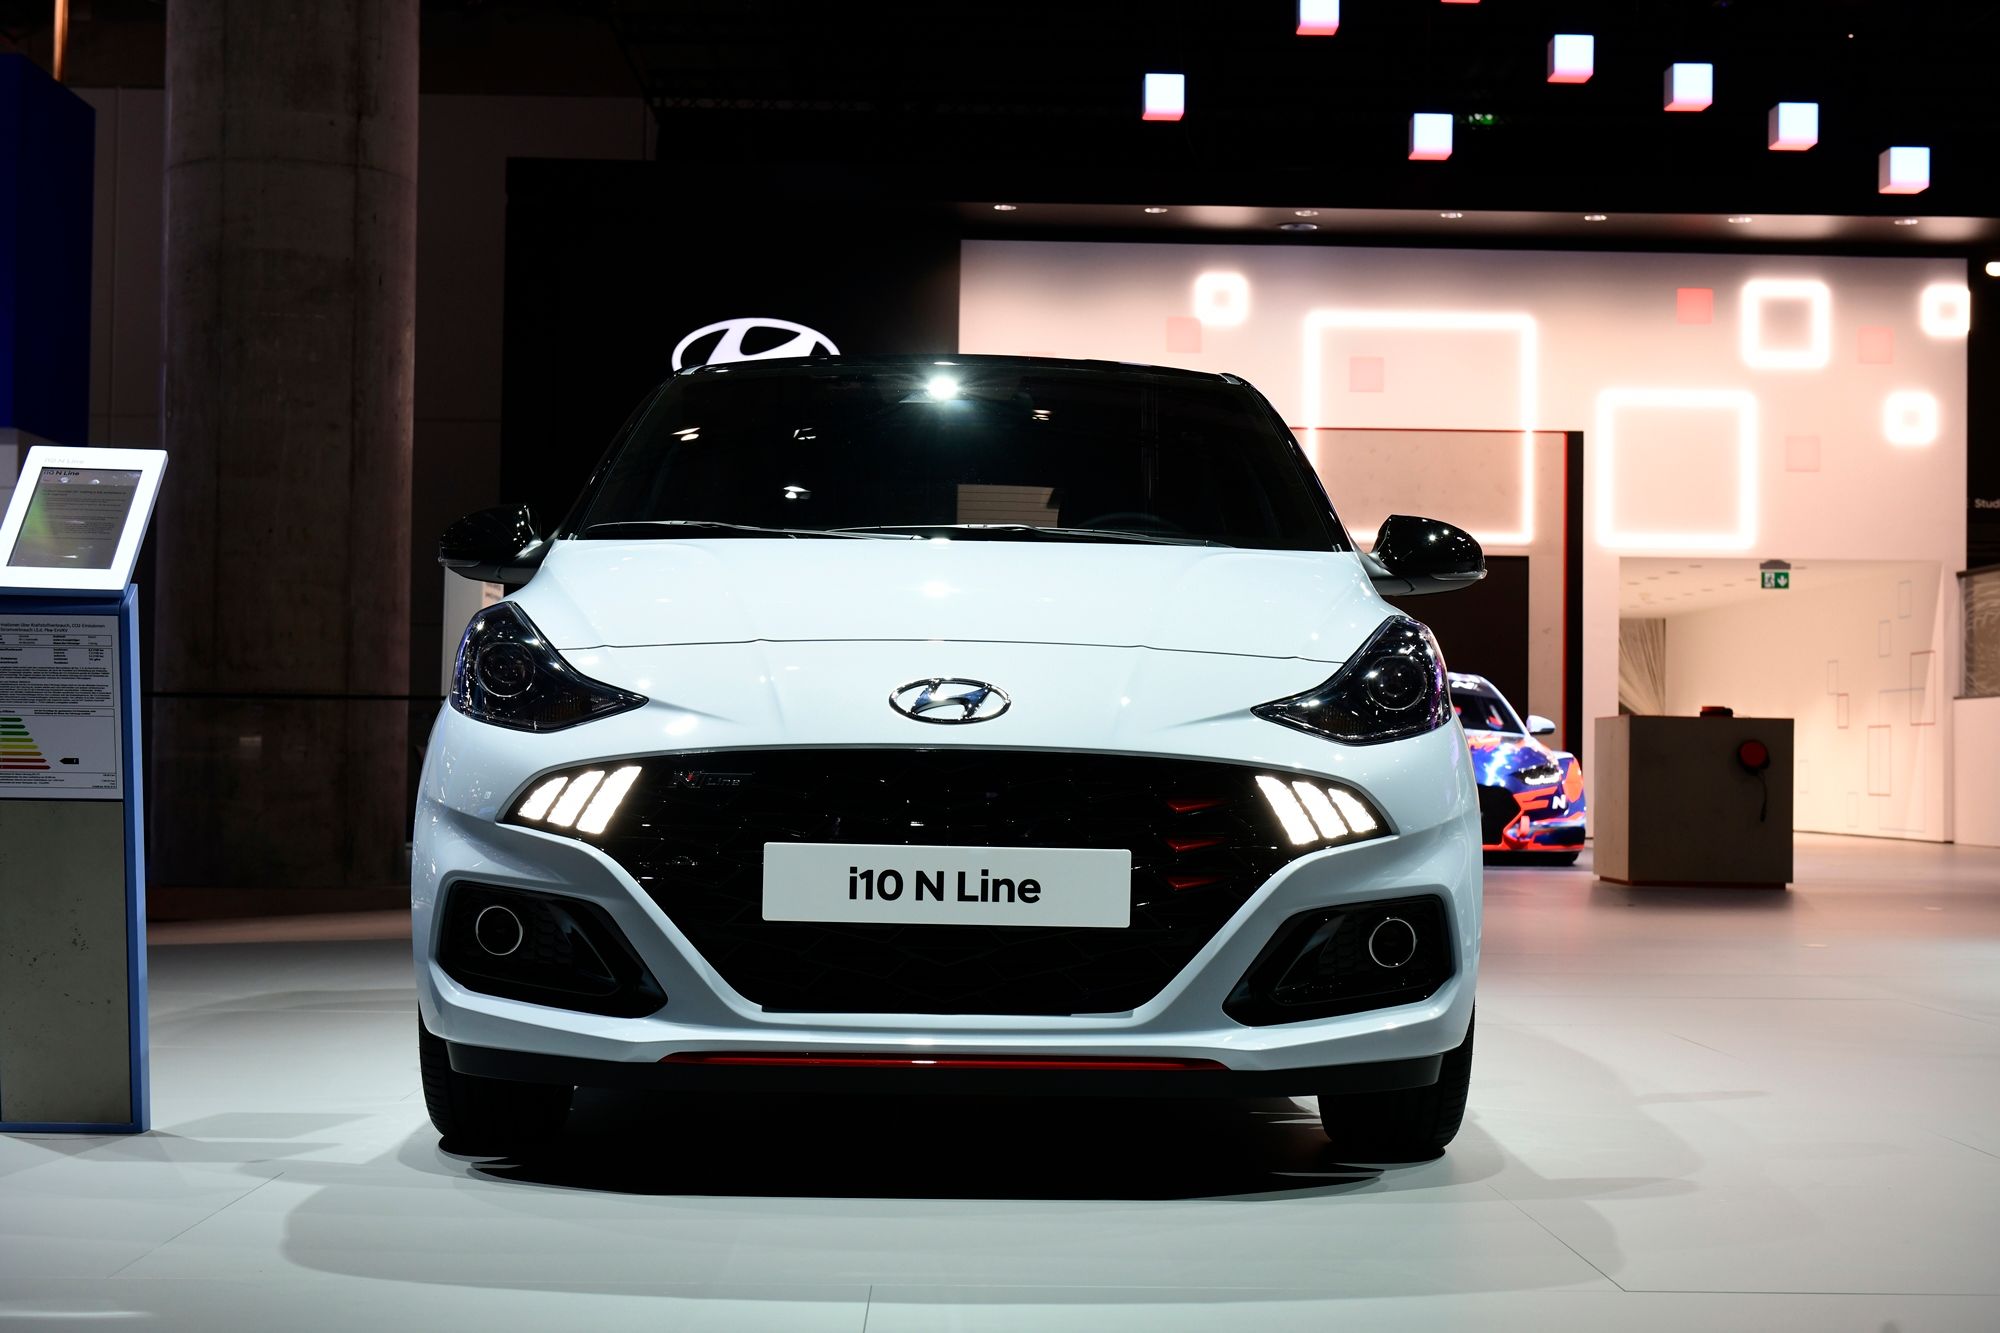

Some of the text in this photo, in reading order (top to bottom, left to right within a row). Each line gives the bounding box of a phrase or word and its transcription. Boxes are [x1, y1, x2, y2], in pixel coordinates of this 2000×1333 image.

[1552, 795, 1566, 809] N
[849, 866, 1042, 904] i10 N Line
